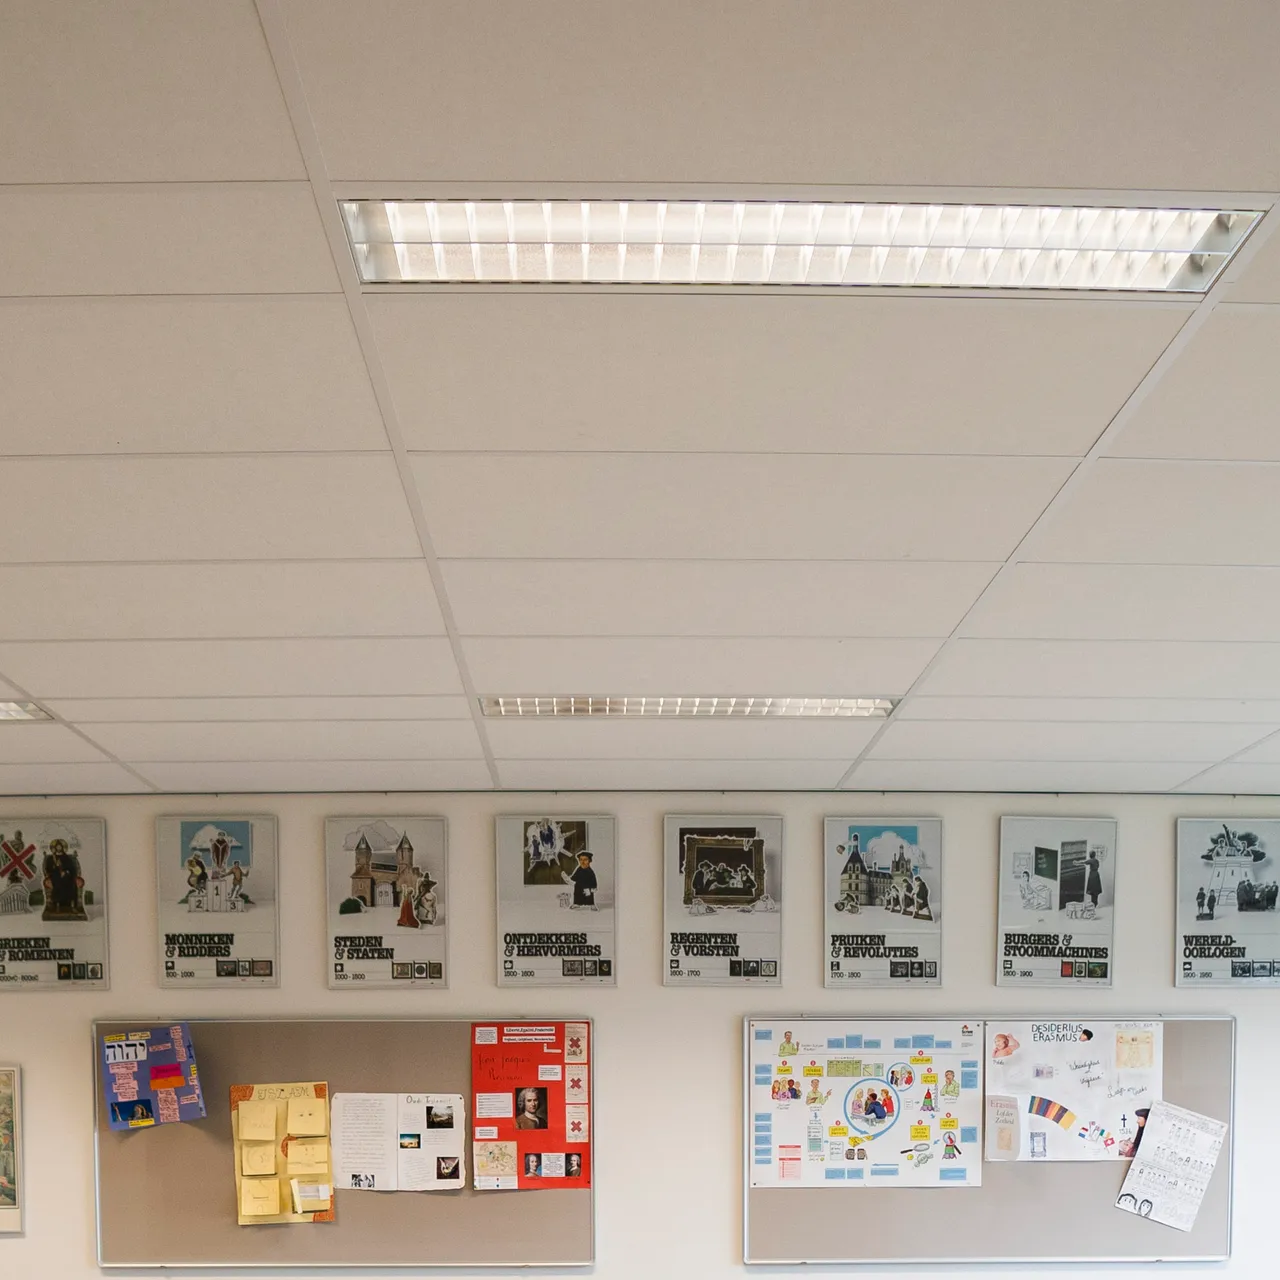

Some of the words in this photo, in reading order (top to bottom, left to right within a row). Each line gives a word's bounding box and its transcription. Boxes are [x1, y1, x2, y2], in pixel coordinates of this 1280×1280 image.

[165, 934, 234, 945] MONNIKEN
[334, 936, 383, 948] STEDEN
[504, 933, 587, 944] ONTDEKKERS
[670, 933, 737, 944] REGENTEN
[831, 935, 886, 946] PRUIKEN
[1004, 933, 1059, 945] BURGERS
[1062, 934, 1072, 946] &
[1183, 935, 1236, 946] WERELD-
[8, 948, 75, 961] ROMEINEN
[165, 945, 176, 957] &
[178, 945, 231, 957] RIDDERS
[335, 947, 345, 960] &
[347, 948, 394, 959] STATEN
[504, 944, 514, 957] &
[517, 945, 601, 956] HERVORMERS
[671, 944, 681, 956] &
[683, 945, 739, 956] VORSTEN
[831, 946, 841, 958] &
[843, 946, 919, 958] REVOLUTIES
[1004, 945, 1108, 958] STOOMMACHINES
[1183, 947, 1246, 958] OORLOGEN
[1032, 1023, 1083, 1033] DESIDERIUS
[1033, 1032, 1077, 1042] ERASMUS
